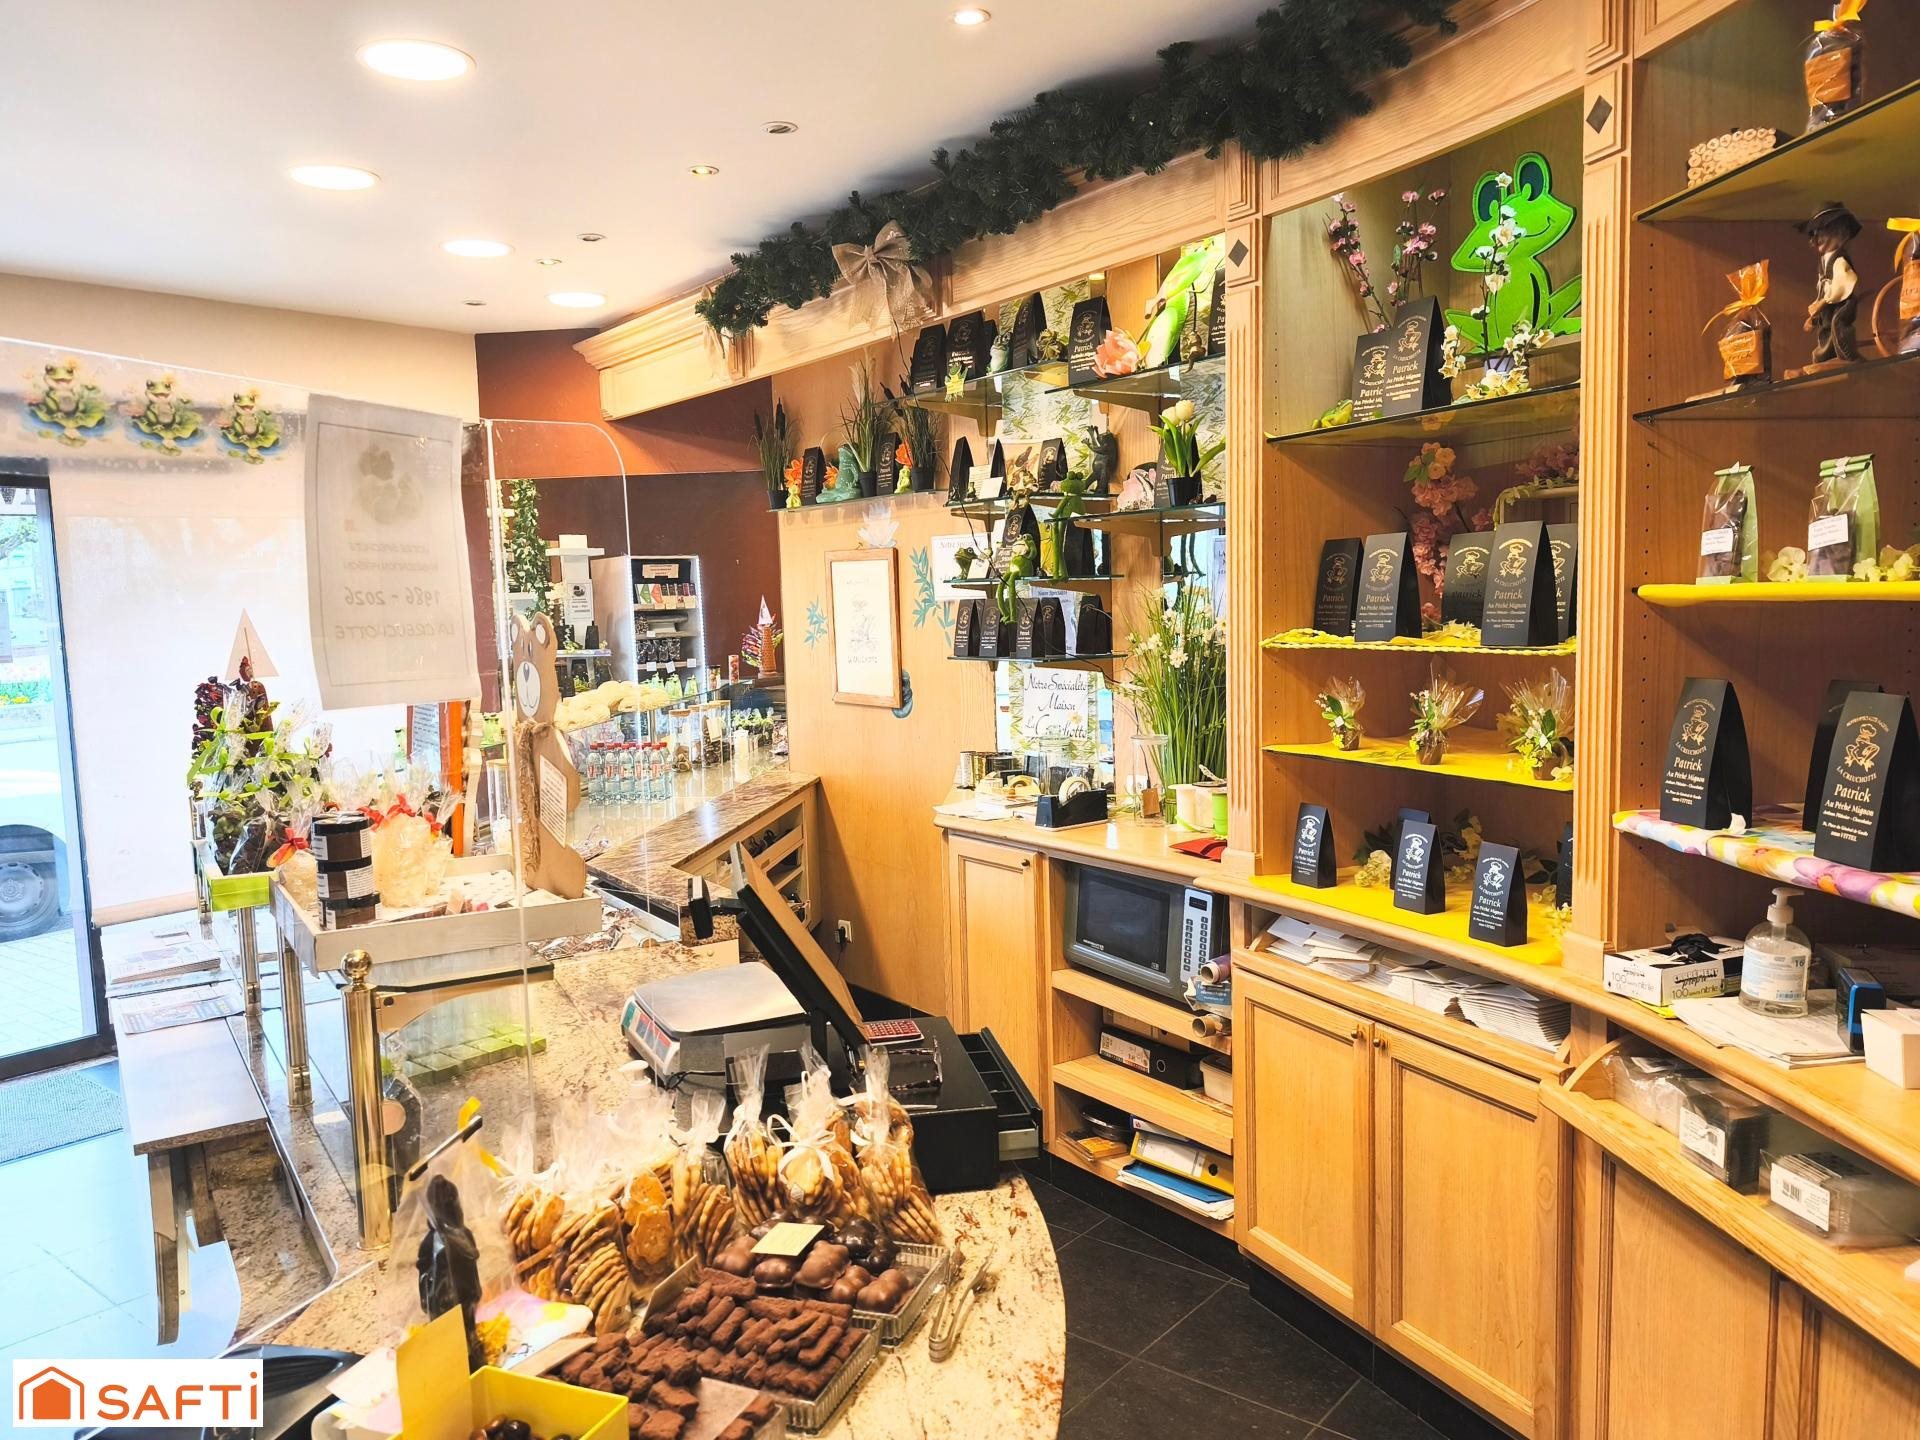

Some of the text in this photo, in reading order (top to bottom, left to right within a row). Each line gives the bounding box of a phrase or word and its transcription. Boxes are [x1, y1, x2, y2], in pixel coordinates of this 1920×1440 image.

[1392, 361, 1418, 374] Patrick
[1360, 388, 1383, 398] Patric
[1366, 593, 1390, 602] Patrick
[1494, 589, 1523, 600] Patrick
[1024, 673, 1048, 690] Notre
[1038, 692, 1076, 711] Maison
[1674, 756, 1702, 772] Patrick
[1834, 783, 1872, 803] Patrick
[1824, 800, 1834, 808] Au
[1852, 805, 1874, 817] Mignon
[1402, 869, 1421, 879] Patrick
[1479, 896, 1501, 908] Patrick
[1612, 972, 1627, 984] 100
[1672, 988, 1689, 999] 100
